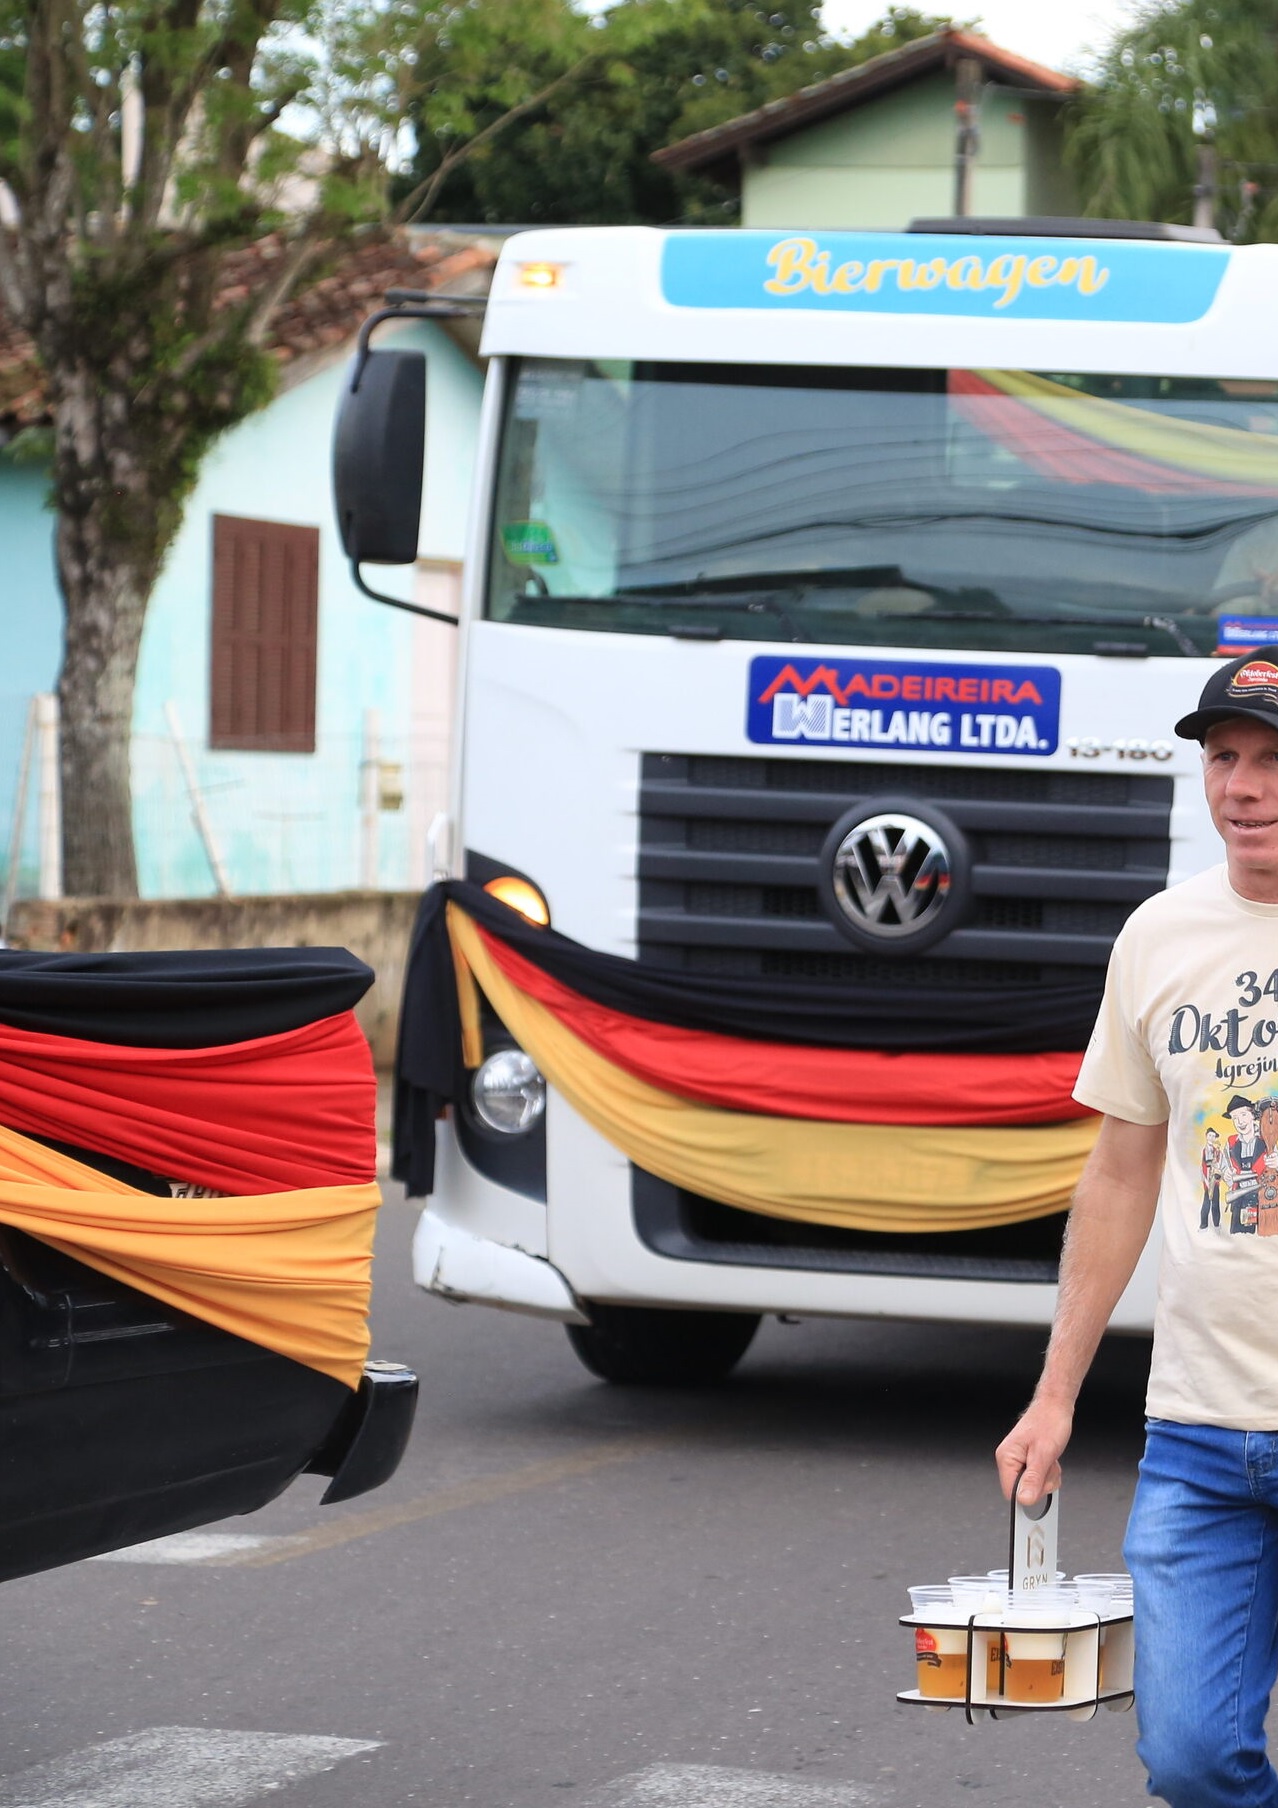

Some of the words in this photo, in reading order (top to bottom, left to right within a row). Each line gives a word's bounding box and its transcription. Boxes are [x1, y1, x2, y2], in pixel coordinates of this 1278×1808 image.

[763, 237, 1109, 309] Bierwagen
[758, 664, 1043, 707] MADEIREIRA
[772, 693, 951, 746] WERLANG
[959, 711, 1049, 750] LTDA.
[1066, 736, 1174, 761] 13-180
[1022, 1572, 1048, 1590] GRYN
